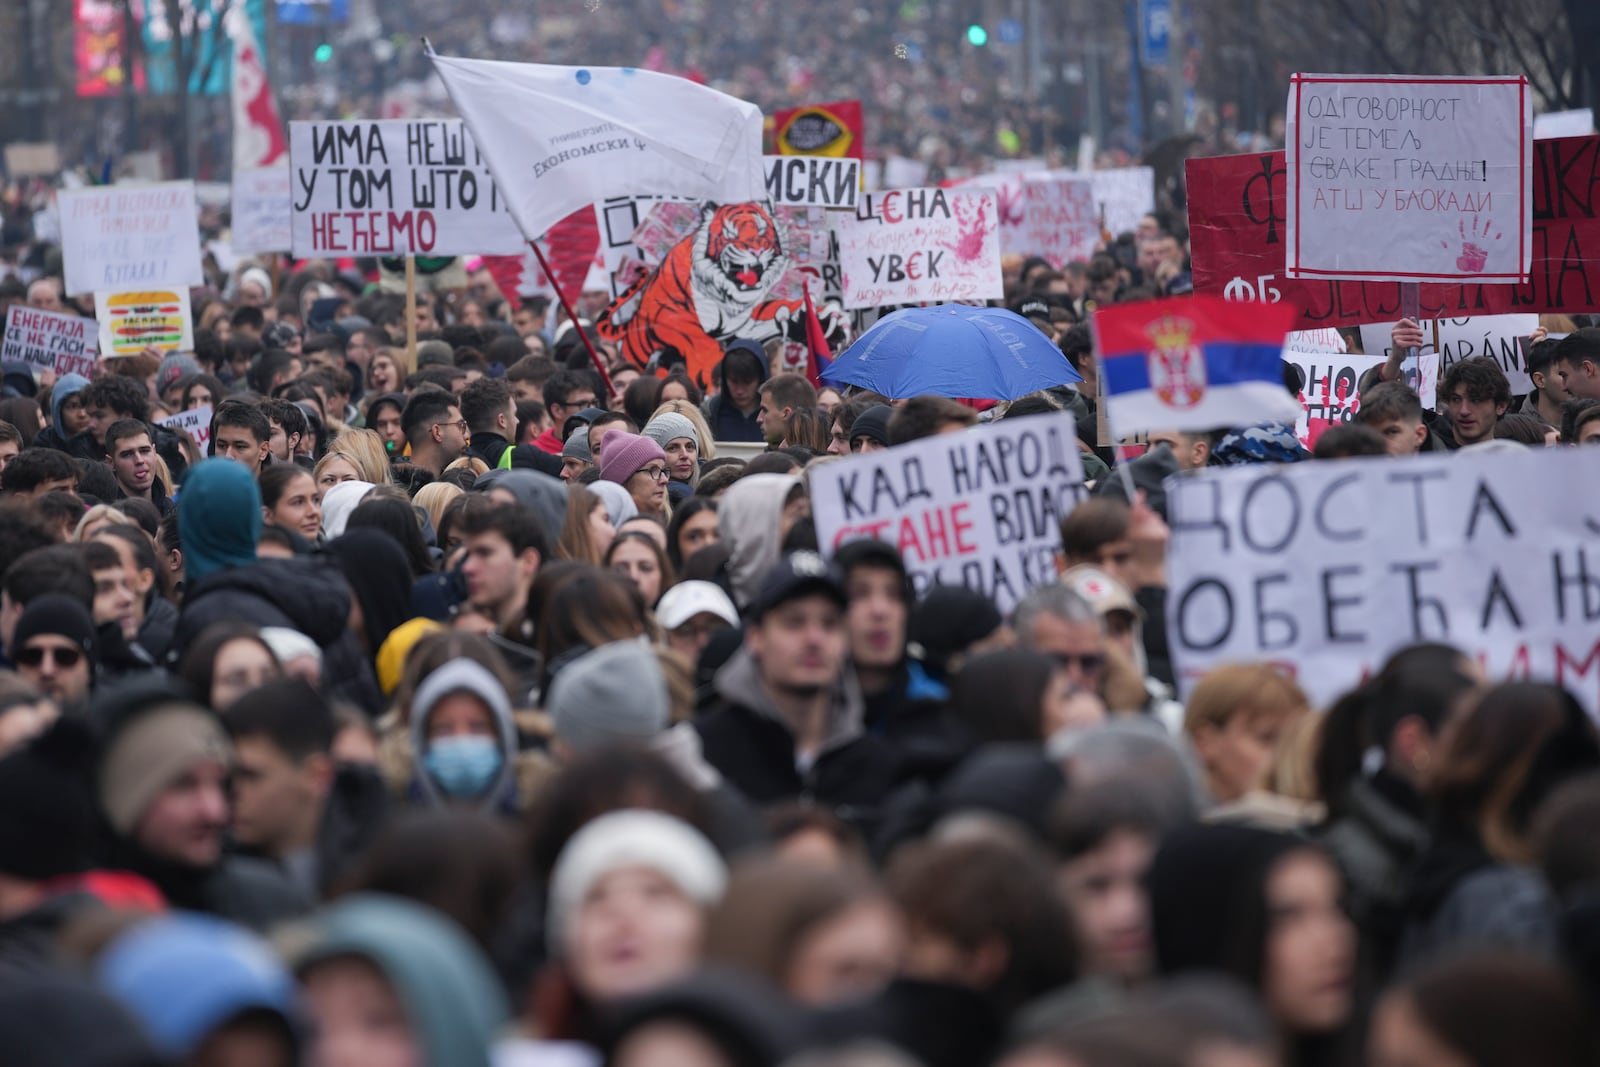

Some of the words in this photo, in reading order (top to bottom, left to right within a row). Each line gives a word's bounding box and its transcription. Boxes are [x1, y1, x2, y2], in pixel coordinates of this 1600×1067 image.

[1307, 95, 1462, 121] ОДГОВОРНОСТ
[312, 123, 388, 165] ИМА
[548, 121, 621, 146] УНИВЕРЗИТЕ
[1304, 125, 1332, 149] ЈЕ
[1337, 127, 1421, 150] ТЕМЕЉ
[532, 137, 631, 179] ЕКОНОМСКИ
[293, 167, 318, 212] У
[327, 168, 393, 210] ТОМ
[411, 168, 478, 210] ШТО
[1313, 187, 1363, 211] АТШ
[1374, 189, 1388, 209] У
[1394, 188, 1492, 212] БЛОКАДИ
[311, 210, 437, 253] НЕЋЕМО
[12, 309, 84, 339] ЕНЕРГИЈА
[4, 342, 21, 358] НИ
[24, 346, 56, 369] НАША
[7, 326, 20, 341] СЕ
[26, 331, 45, 347] НЕ
[50, 335, 85, 355] ГАСИ
[838, 456, 933, 521] КАД
[948, 428, 1069, 495] НАРОД
[1166, 469, 1521, 556] ДОСТА
